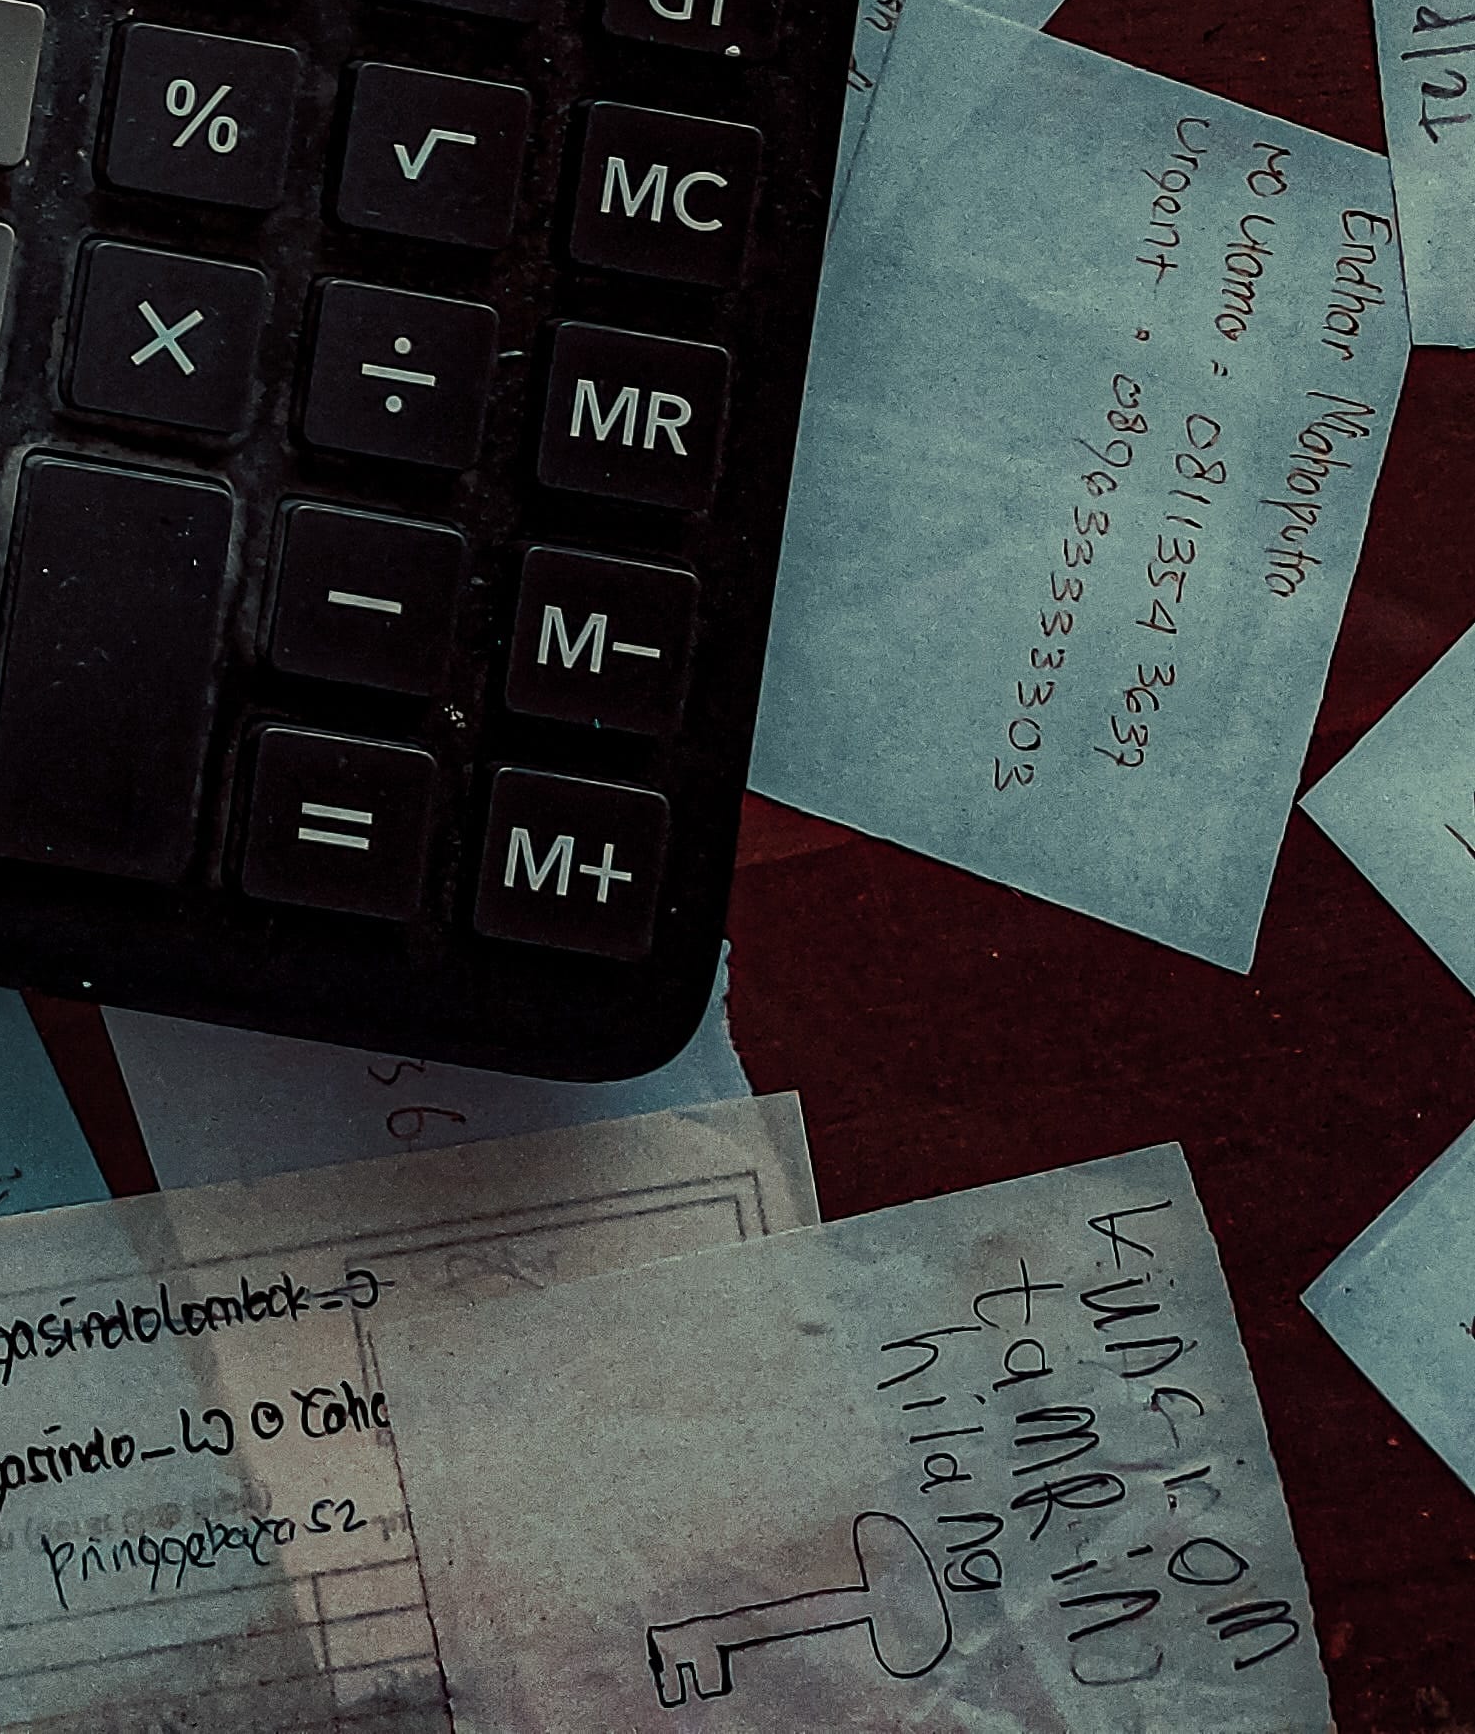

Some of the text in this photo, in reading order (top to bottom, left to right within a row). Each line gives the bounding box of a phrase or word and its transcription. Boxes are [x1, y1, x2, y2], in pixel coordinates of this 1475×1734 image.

[599, 155, 728, 232] MC
[569, 377, 694, 457] MR
[503, 826, 633, 904] M+
